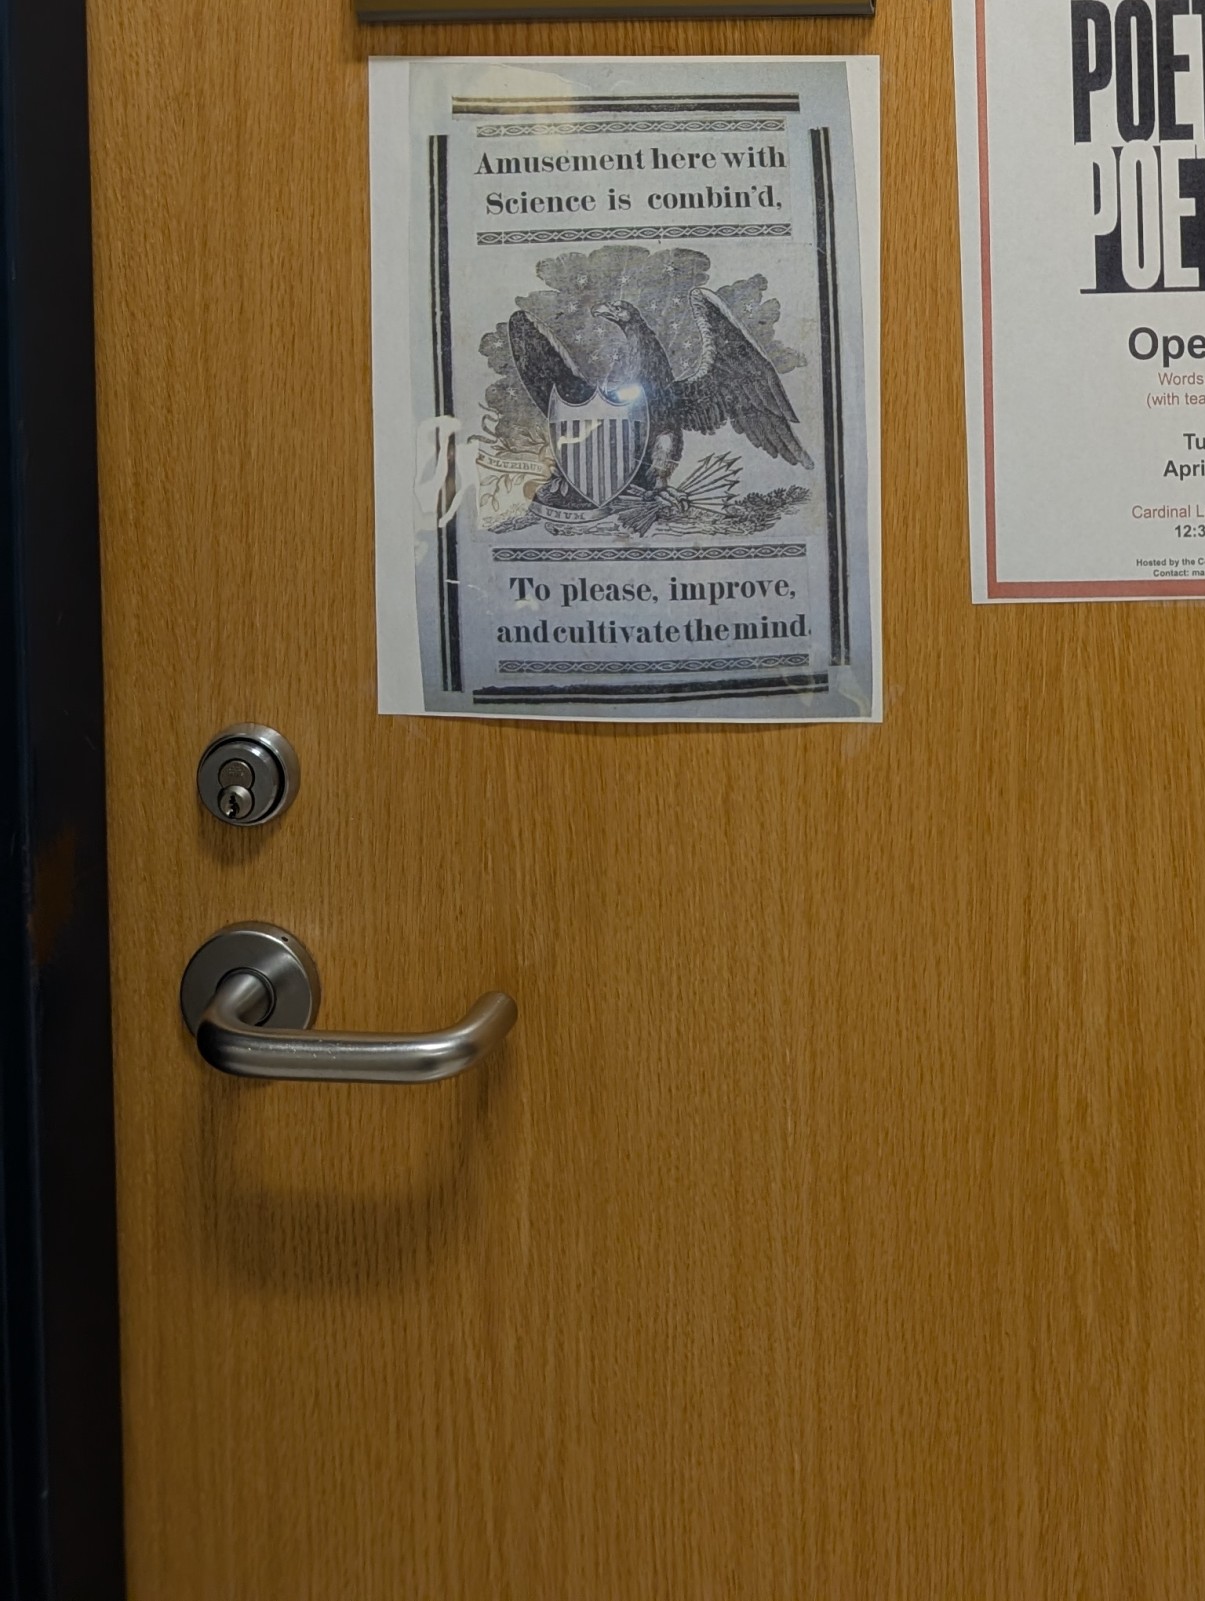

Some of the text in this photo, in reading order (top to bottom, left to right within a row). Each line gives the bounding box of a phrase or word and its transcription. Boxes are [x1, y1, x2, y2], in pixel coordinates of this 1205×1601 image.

[475, 146, 786, 174] Amusement here with
[487, 192, 595, 214] Science
[609, 189, 631, 210] is
[1147, 393, 1179, 408] (with
[1185, 393, 1205, 405] tea
[1132, 505, 1190, 519] Cardinal
[1169, 559, 1179, 567] by
[510, 577, 795, 607] To please, improve,
[497, 620, 548, 643] and
[553, 621, 679, 643] cultivate
[685, 619, 729, 642] the
